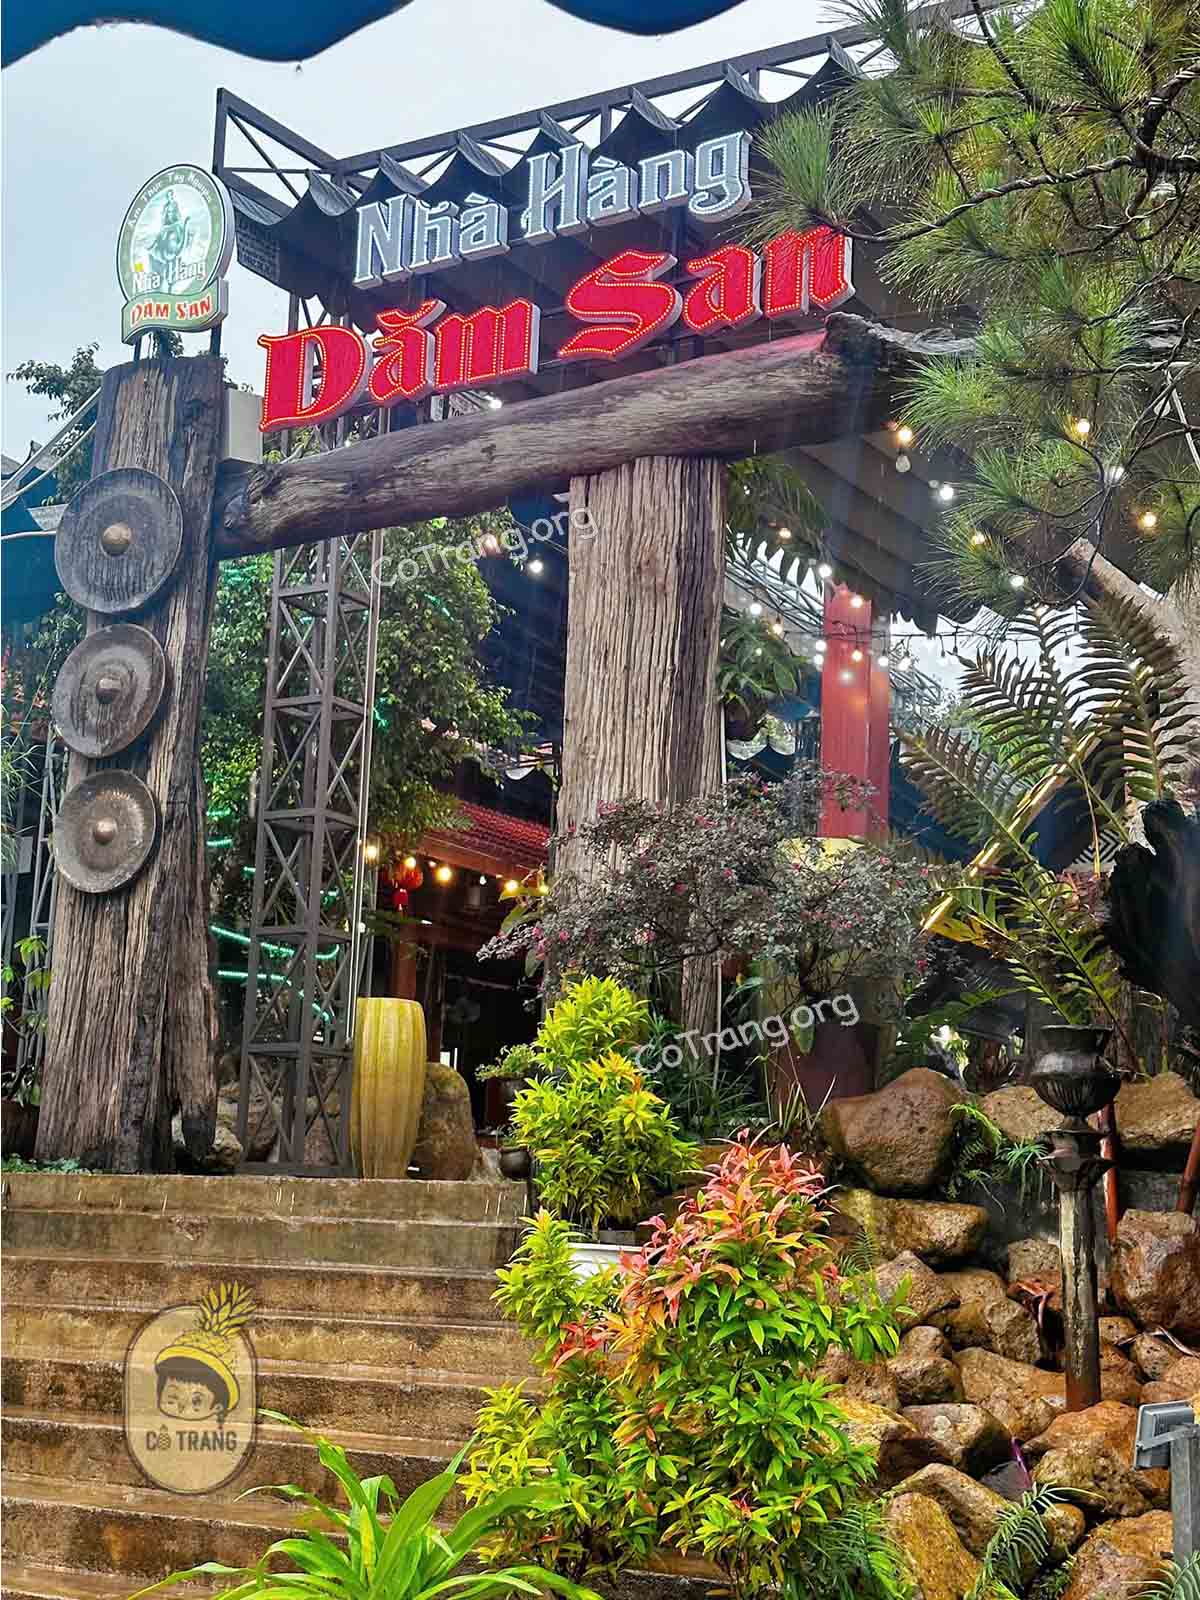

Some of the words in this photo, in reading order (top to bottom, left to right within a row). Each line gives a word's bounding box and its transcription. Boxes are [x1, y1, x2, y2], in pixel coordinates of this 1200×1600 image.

[353, 191, 509, 287] Nhà
[520, 130, 752, 245] Hàng
[257, 297, 540, 433] Dăm
[558, 226, 855, 361] San
